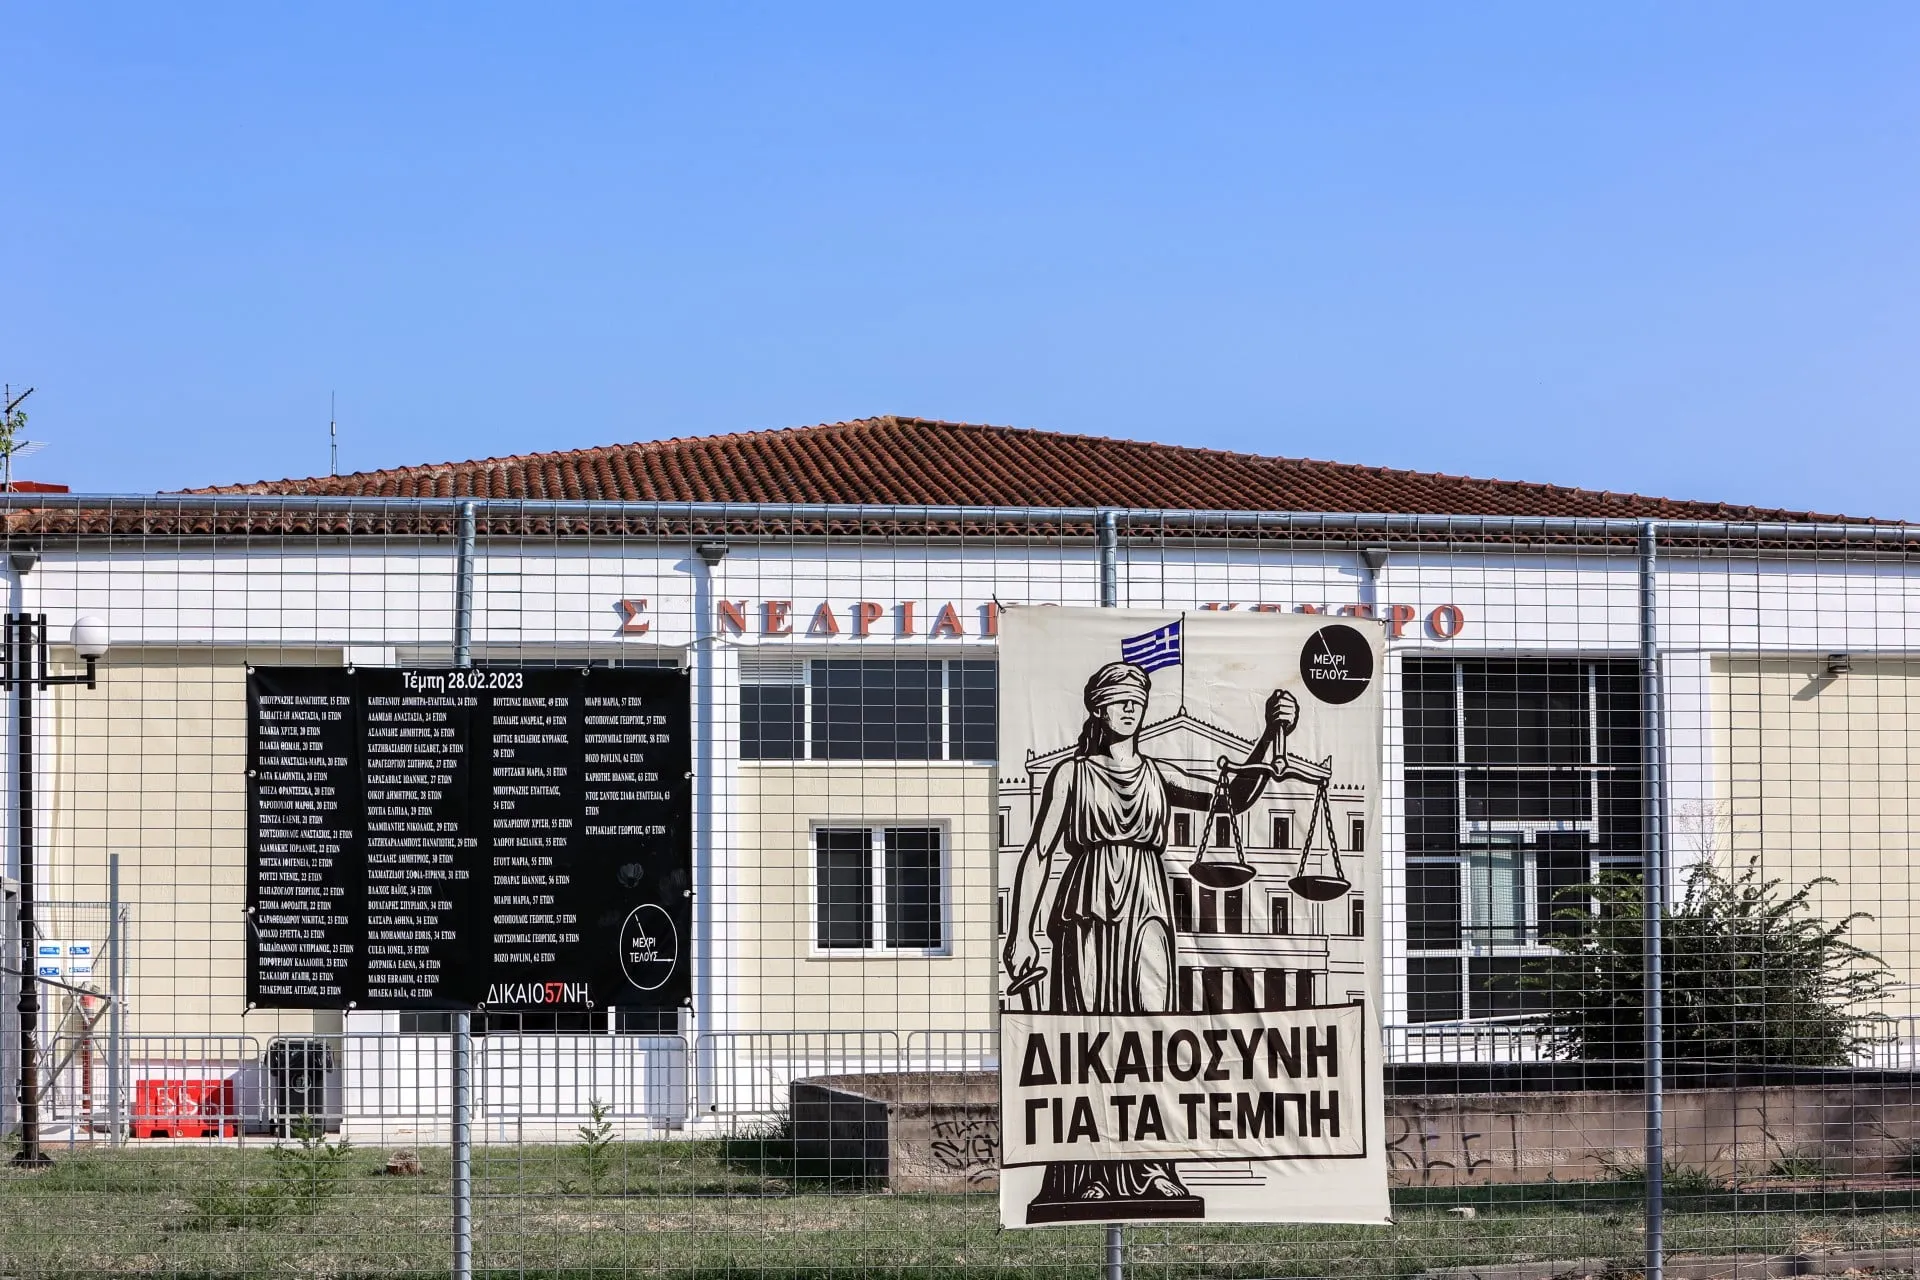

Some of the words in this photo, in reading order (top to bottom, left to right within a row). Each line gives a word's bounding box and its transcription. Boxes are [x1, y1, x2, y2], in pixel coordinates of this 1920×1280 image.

[1313, 654, 1346, 665] ΜΕΧΡΙ
[1309, 669, 1349, 680] ΤΕΛΟΥΣ
[402, 670, 445, 694] Τέμπη
[448, 672, 523, 690] 28.02.2023
[602, 697, 620, 707] ΜΑΡΙΑ,
[628, 697, 642, 706] ΕΤΩΝ
[328, 711, 342, 720] ΕΤΩΝ
[432, 712, 447, 722] ΕΤΩΝ
[653, 715, 666, 725] ΕΤΩΝ
[440, 728, 455, 737] ΕΤΩΝ
[656, 734, 670, 743] ΕΤΩΝ
[449, 743, 464, 753] ΕΤΩΝ
[500, 748, 515, 758] ΕΤΩΝ
[630, 753, 644, 763] ΕΤΩΝ
[443, 759, 457, 768] ΕΤΩΝ
[526, 767, 545, 778] ΜΑΡΙΑ,
[553, 767, 567, 776] ΕΤΩΝ
[612, 772, 637, 782] ΙΩΑΝΝΗΣ,
[644, 772, 658, 782] ΕΤΩΝ
[403, 775, 429, 785] ΙΩΑΝΝΗΣ,
[437, 775, 452, 784] ΕΤΩΝ
[427, 790, 442, 800] ΕΤΩΝ
[387, 806, 409, 816] ΕΛΠΙΔΑ,
[418, 806, 432, 816] ΕΤΩΝ
[443, 822, 458, 832] ΕΤΩΝ
[652, 825, 666, 834] ΕΤΩΝ
[326, 844, 340, 853] ΕΤΩΝ
[511, 857, 530, 867] ΜΑΡΙΑ,
[538, 856, 553, 866] ΕΤΩΝ
[521, 875, 547, 886] ΙΩΑΝΝΗΣ,
[555, 875, 570, 884] ΕΤΩΝ
[330, 887, 344, 896] ΕΤΩΝ
[317, 901, 331, 910] ΕΤΩΝ
[512, 895, 531, 906] ΜΑΡΙΑ,
[540, 895, 554, 904] ΕΤΩΝ
[301, 915, 326, 925] ΝΙΚΗΤΑΣ,
[334, 915, 348, 925] ΕΤΩΝ
[394, 916, 415, 926] ΑΘΗΝΑ,
[423, 916, 438, 925] ΕΤΩΝ
[563, 914, 577, 923] ΕΤΩΝ
[441, 930, 456, 940] ΕΤΩΝ
[565, 933, 579, 942] ΕΤΩΝ
[632, 937, 656, 948] ΜΕΧΡΙ
[339, 944, 354, 953] ΕΤΩΝ
[368, 945, 386, 954] CULEA
[387, 945, 406, 956] IONEL,
[414, 945, 429, 954] ΕΤΩΝ
[541, 953, 555, 962] ΕΤΩΝ
[629, 951, 658, 962] ΤΕΛΟΥΣ
[333, 958, 348, 967] ΕΤΩΝ
[398, 960, 417, 970] ΕΛΕΝΑ,
[426, 960, 441, 969] ΕΤΩΝ
[387, 974, 415, 984] EBRAHIM,
[424, 974, 439, 983] ΕΤΩΝ
[486, 982, 588, 1004] ΔΙΚΑΙΟ57ΝΗ
[1019, 1025, 1338, 1087] ΔΙΚΑΙΟΣΥΝΗ
[1024, 1097, 1100, 1145] ΓΙΑ
[1110, 1094, 1167, 1141] ΤΑ
[1179, 1090, 1340, 1139] ΤΕΜΠΗ
